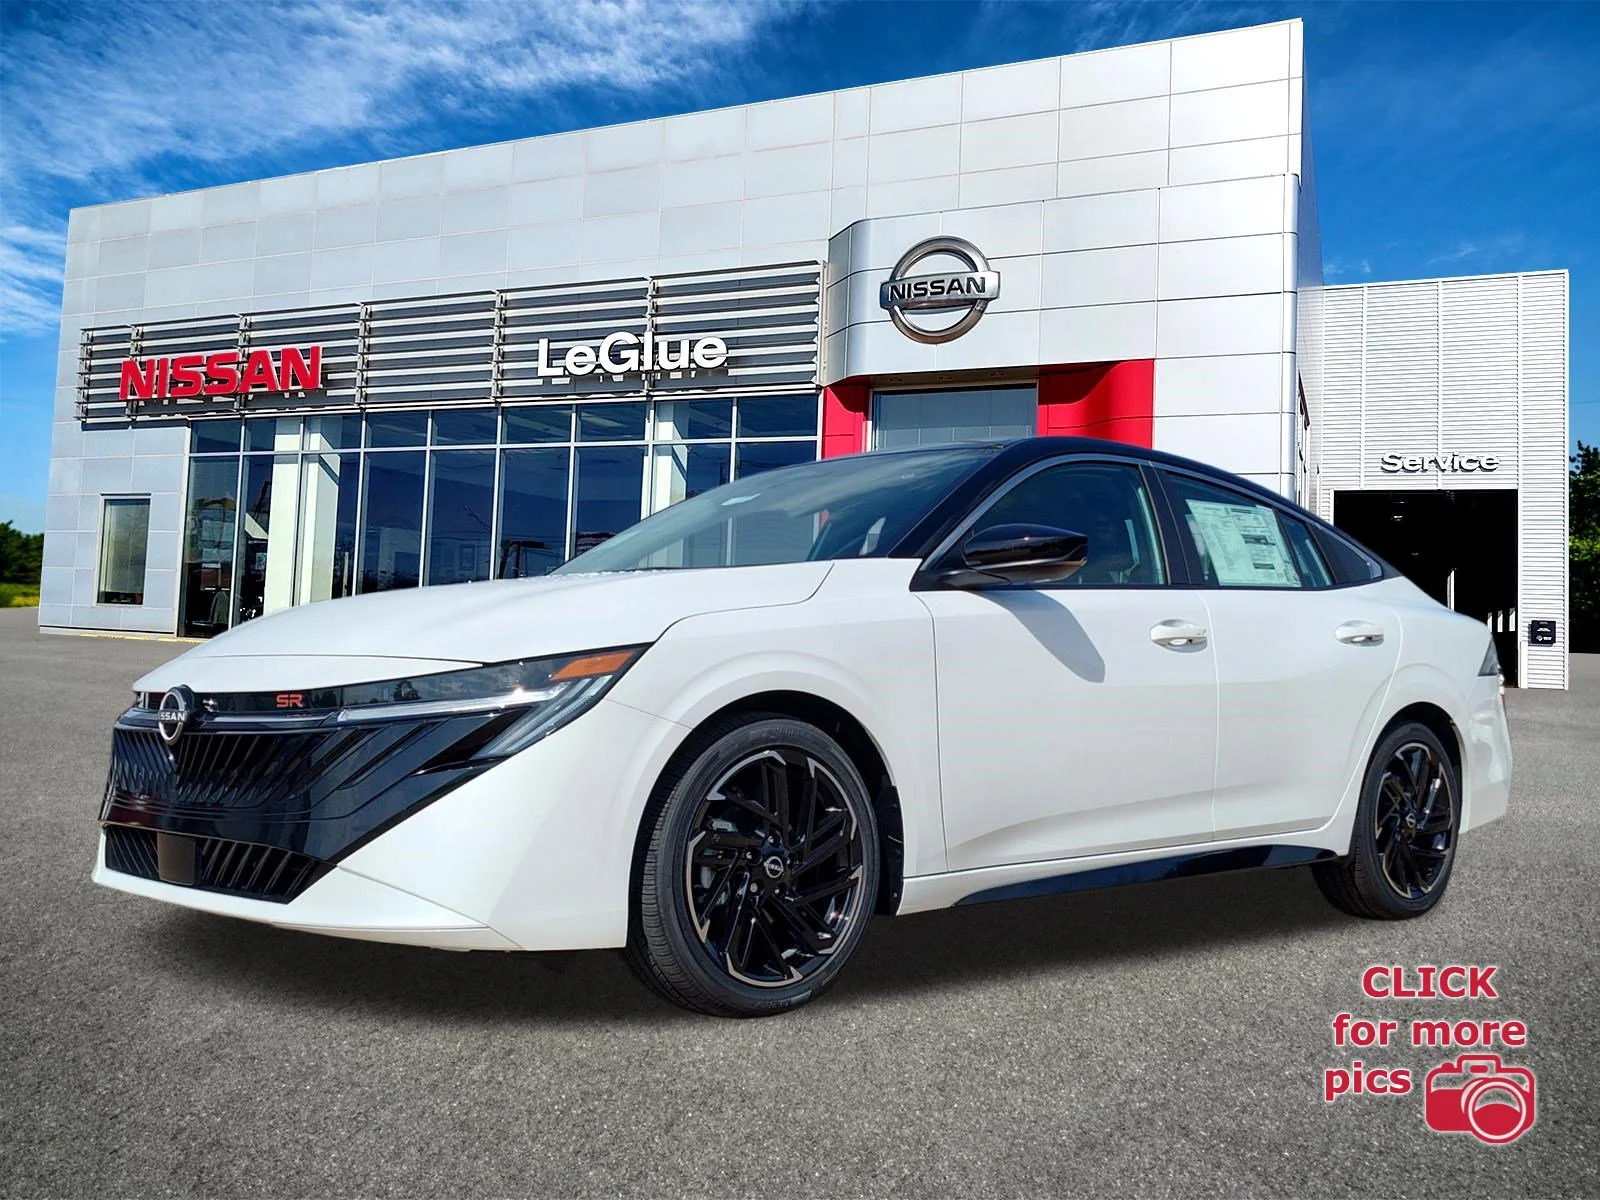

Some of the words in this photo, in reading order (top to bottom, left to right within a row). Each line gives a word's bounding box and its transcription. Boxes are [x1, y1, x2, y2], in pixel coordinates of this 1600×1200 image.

[888, 277, 985, 302] NISSAN
[537, 331, 729, 377] LeGlue
[119, 345, 322, 401] NISSAN
[1382, 450, 1500, 473] Service
[276, 693, 304, 708] SR
[160, 711, 186, 722] SSAN
